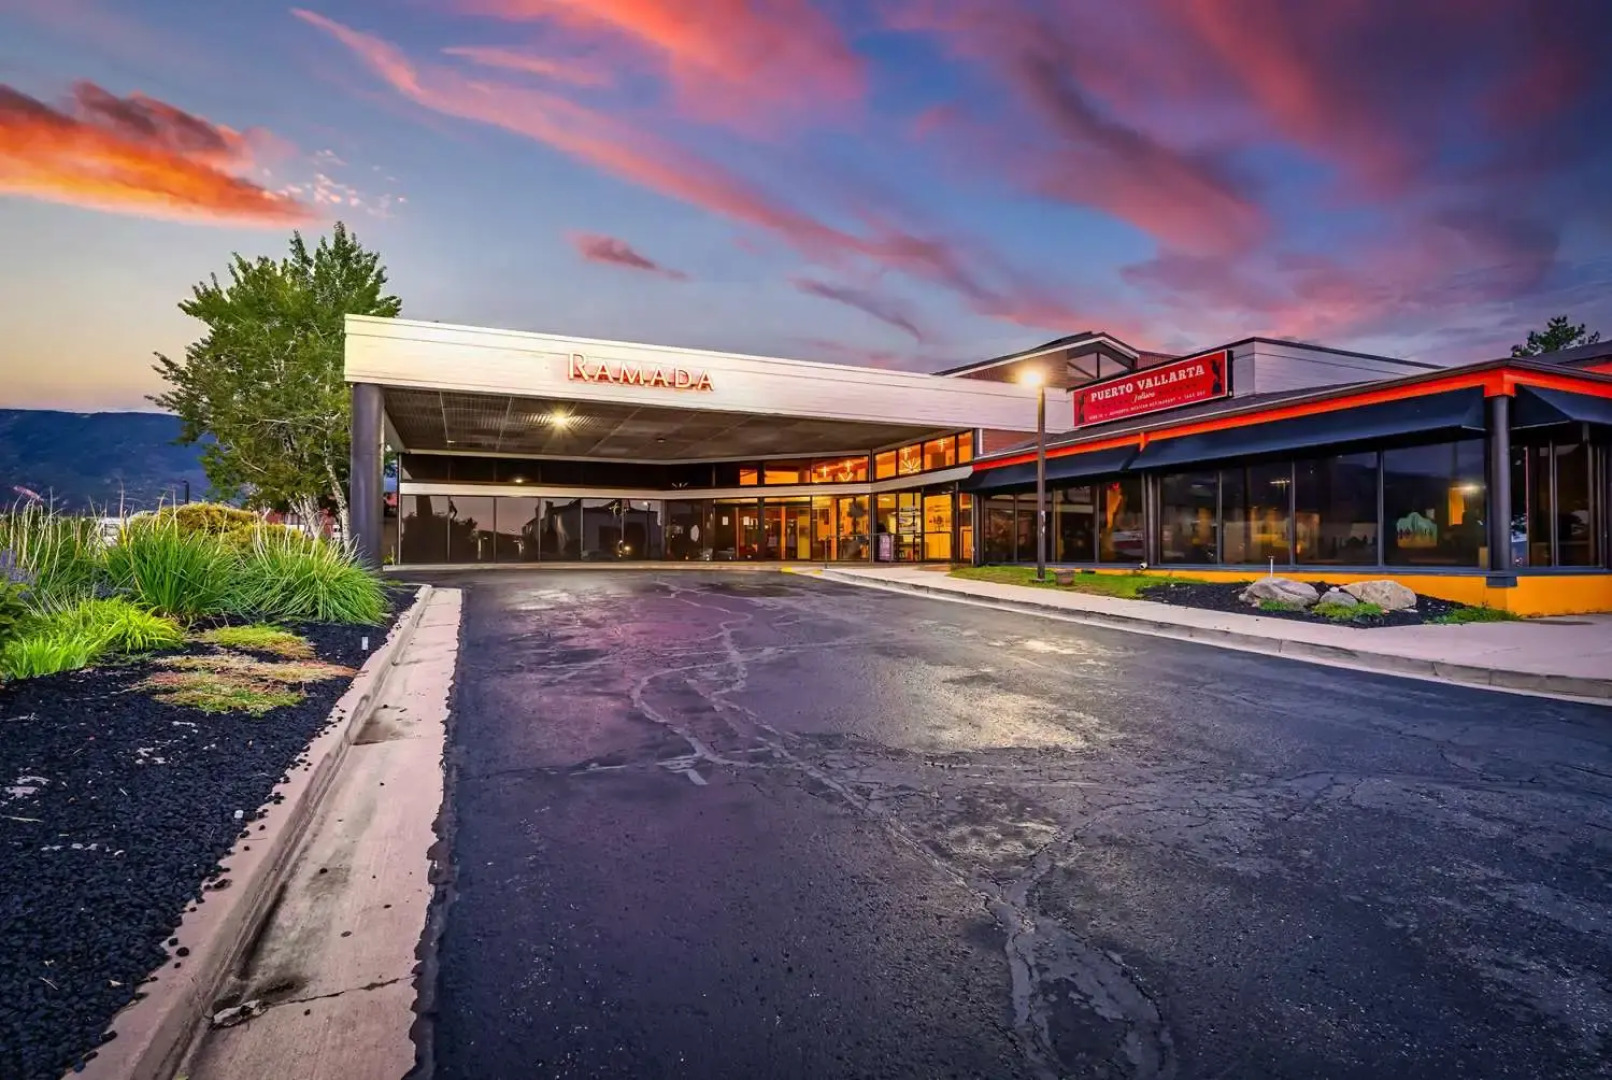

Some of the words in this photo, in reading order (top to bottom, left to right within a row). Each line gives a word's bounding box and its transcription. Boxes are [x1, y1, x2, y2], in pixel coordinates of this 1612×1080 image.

[568, 351, 715, 391] RAMADA
[1090, 383, 1134, 402] PUERTO
[1137, 365, 1204, 390] VALLARTA
